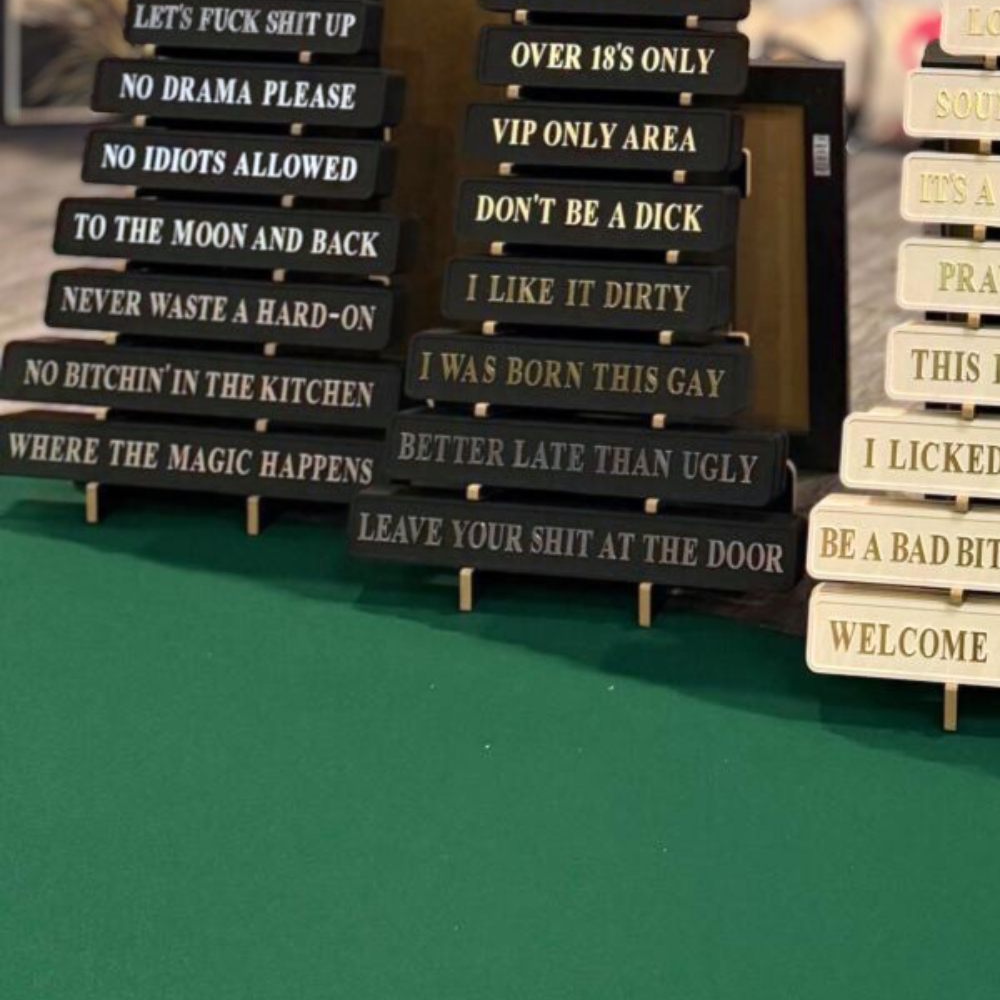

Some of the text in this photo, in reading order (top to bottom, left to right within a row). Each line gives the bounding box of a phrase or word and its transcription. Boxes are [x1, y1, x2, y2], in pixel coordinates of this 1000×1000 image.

[133, 3, 356, 38] LET'S FUCK SHIT UP
[511, 41, 714, 75] OVER 18'S ONLY
[119, 72, 356, 110] NO DRAMA PLEASE
[492, 118, 696, 152] VIP ONLY AREA
[100, 144, 358, 182] NO IDIOTS ALLOWED
[919, 172, 967, 203] IT'S
[973, 177, 995, 205] A
[475, 193, 703, 232] DON'T BE A DICK
[74, 213, 380, 258] TO THE MOON AND BACK
[61, 287, 376, 331] NEVER WASTE A HARD-ON
[467, 274, 691, 312] I LIKE IT DIRTY
[24, 359, 374, 408] NO BITCHIN' IN THE KITCHEN
[419, 352, 725, 398] I WAS BORN THIS GAY
[911, 349, 980, 382] THIS
[9, 432, 374, 485] WHERE THE MAGIC HAPPENS
[398, 431, 759, 484] BETTER LATE THAN UGLY
[864, 438, 876, 468] I
[358, 512, 784, 574] LEAVE YOUR SHIT AT THE DOOR
[820, 527, 856, 559] BE
[862, 532, 881, 561] A
[891, 532, 949, 565] BAD
[830, 619, 988, 663] WELCOME
